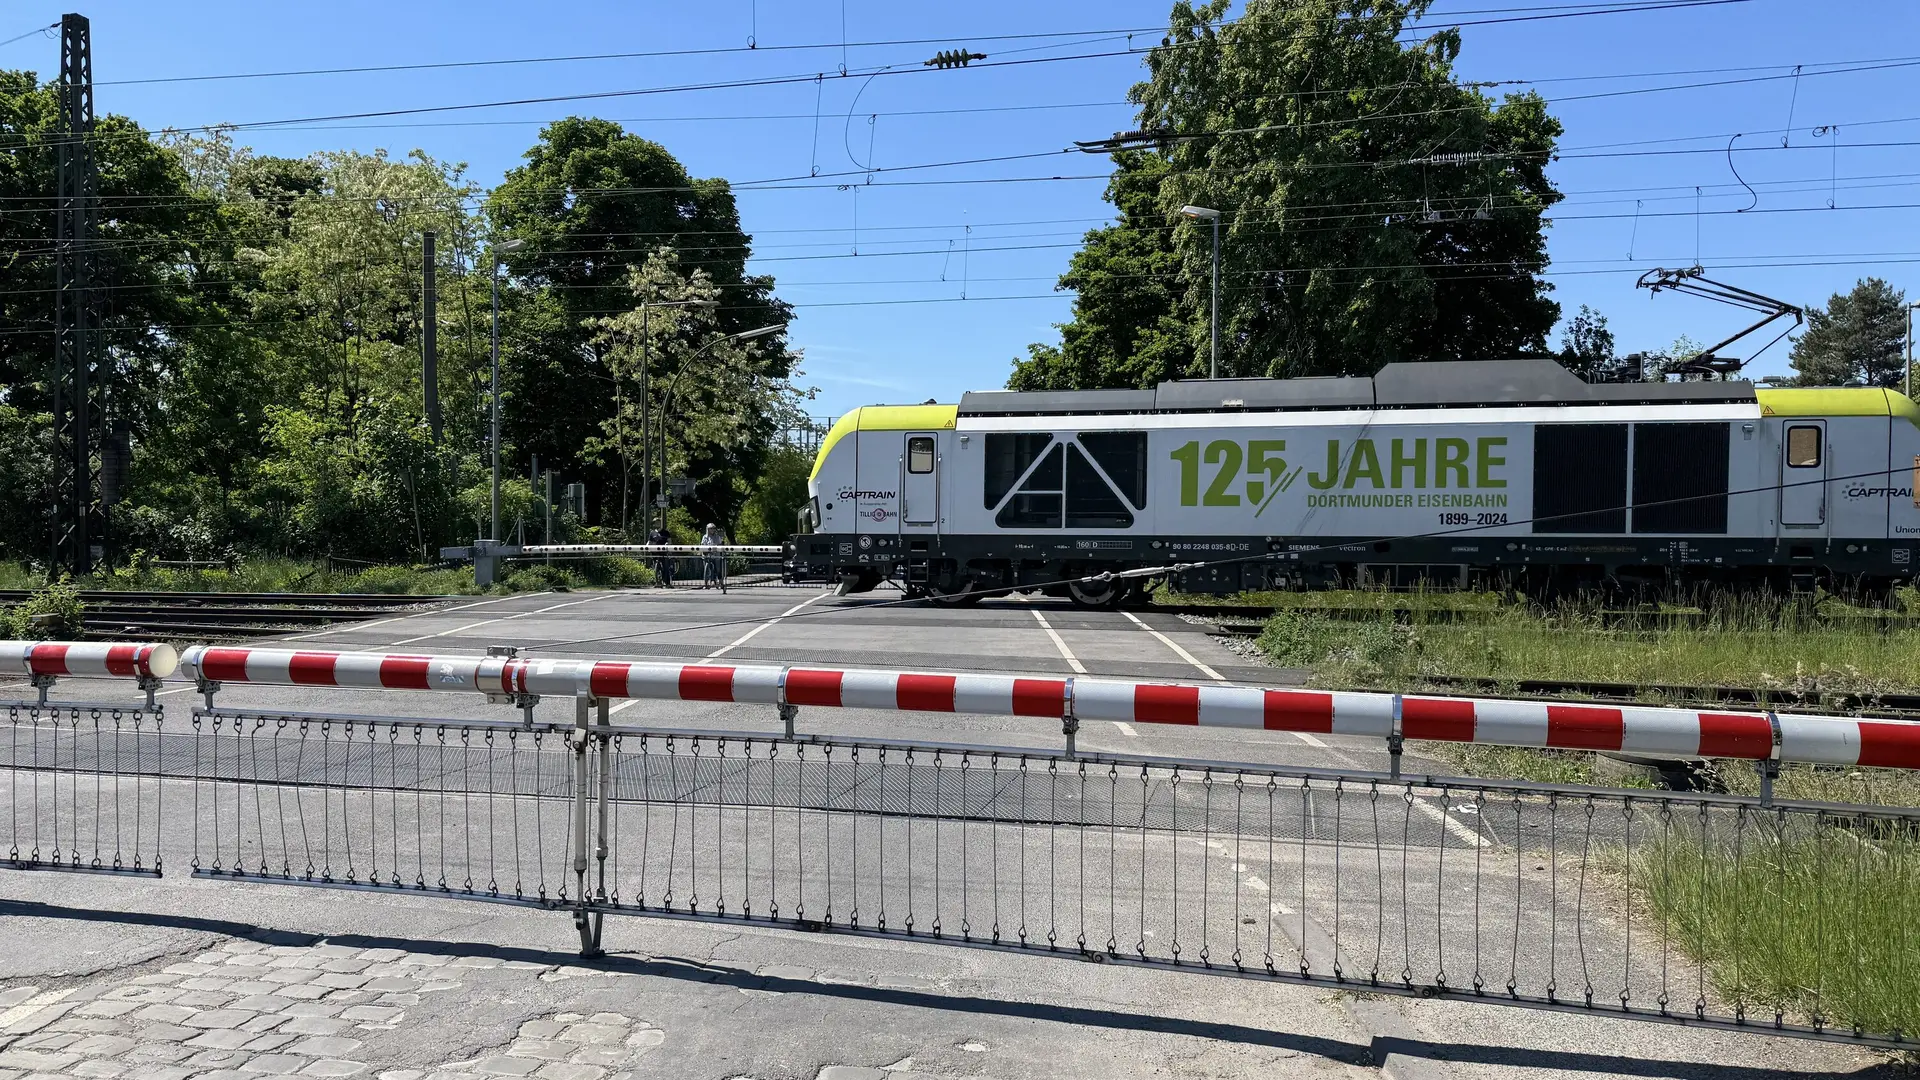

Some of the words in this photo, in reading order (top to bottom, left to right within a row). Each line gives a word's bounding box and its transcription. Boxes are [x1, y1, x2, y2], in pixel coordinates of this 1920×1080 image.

[1170, 439, 1287, 507] 125
[1307, 437, 1508, 490] JAHRE
[840, 491, 896, 499] CAPTRAIN
[1307, 494, 1413, 508] DORTMUNDER
[1417, 494, 1508, 508] EISENBAHN
